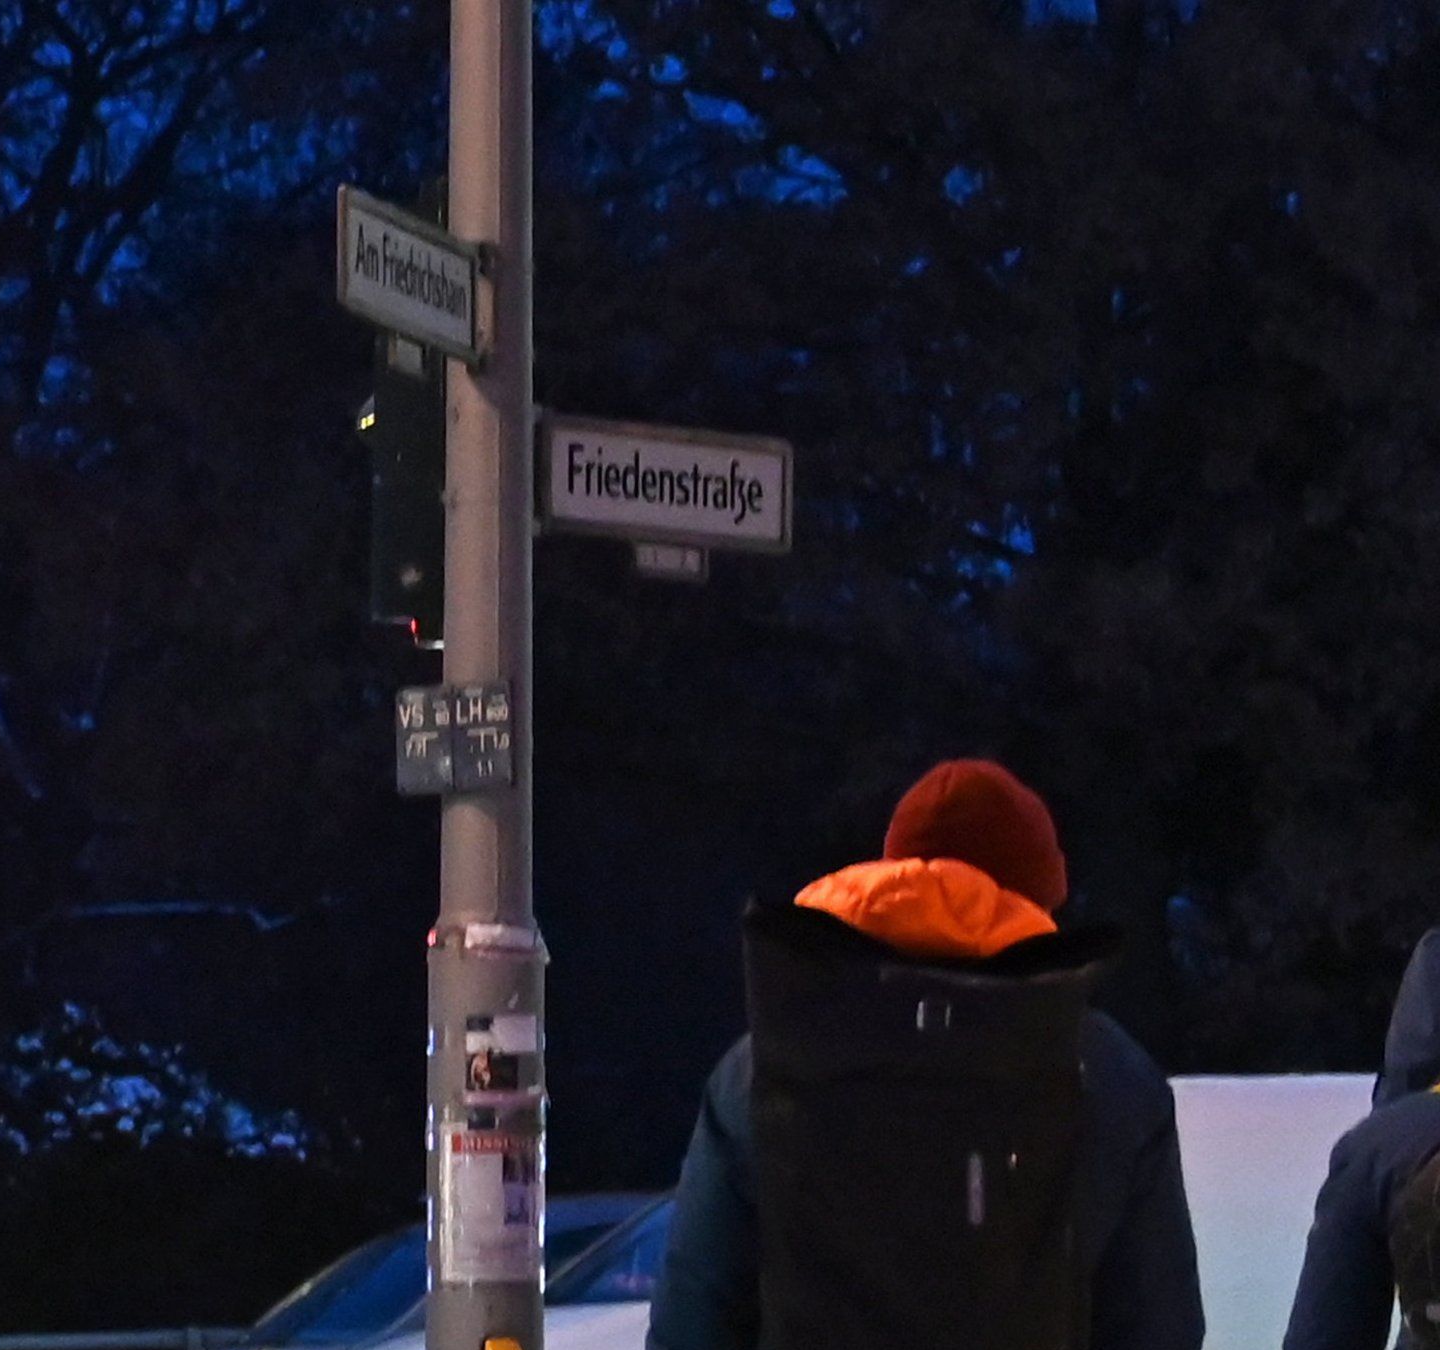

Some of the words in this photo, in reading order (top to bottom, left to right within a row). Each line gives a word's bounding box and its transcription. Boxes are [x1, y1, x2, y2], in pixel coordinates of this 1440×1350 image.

[355, 223, 379, 282] Am
[382, 231, 468, 321] Friedrichshain
[567, 443, 764, 525] Friedenstraße
